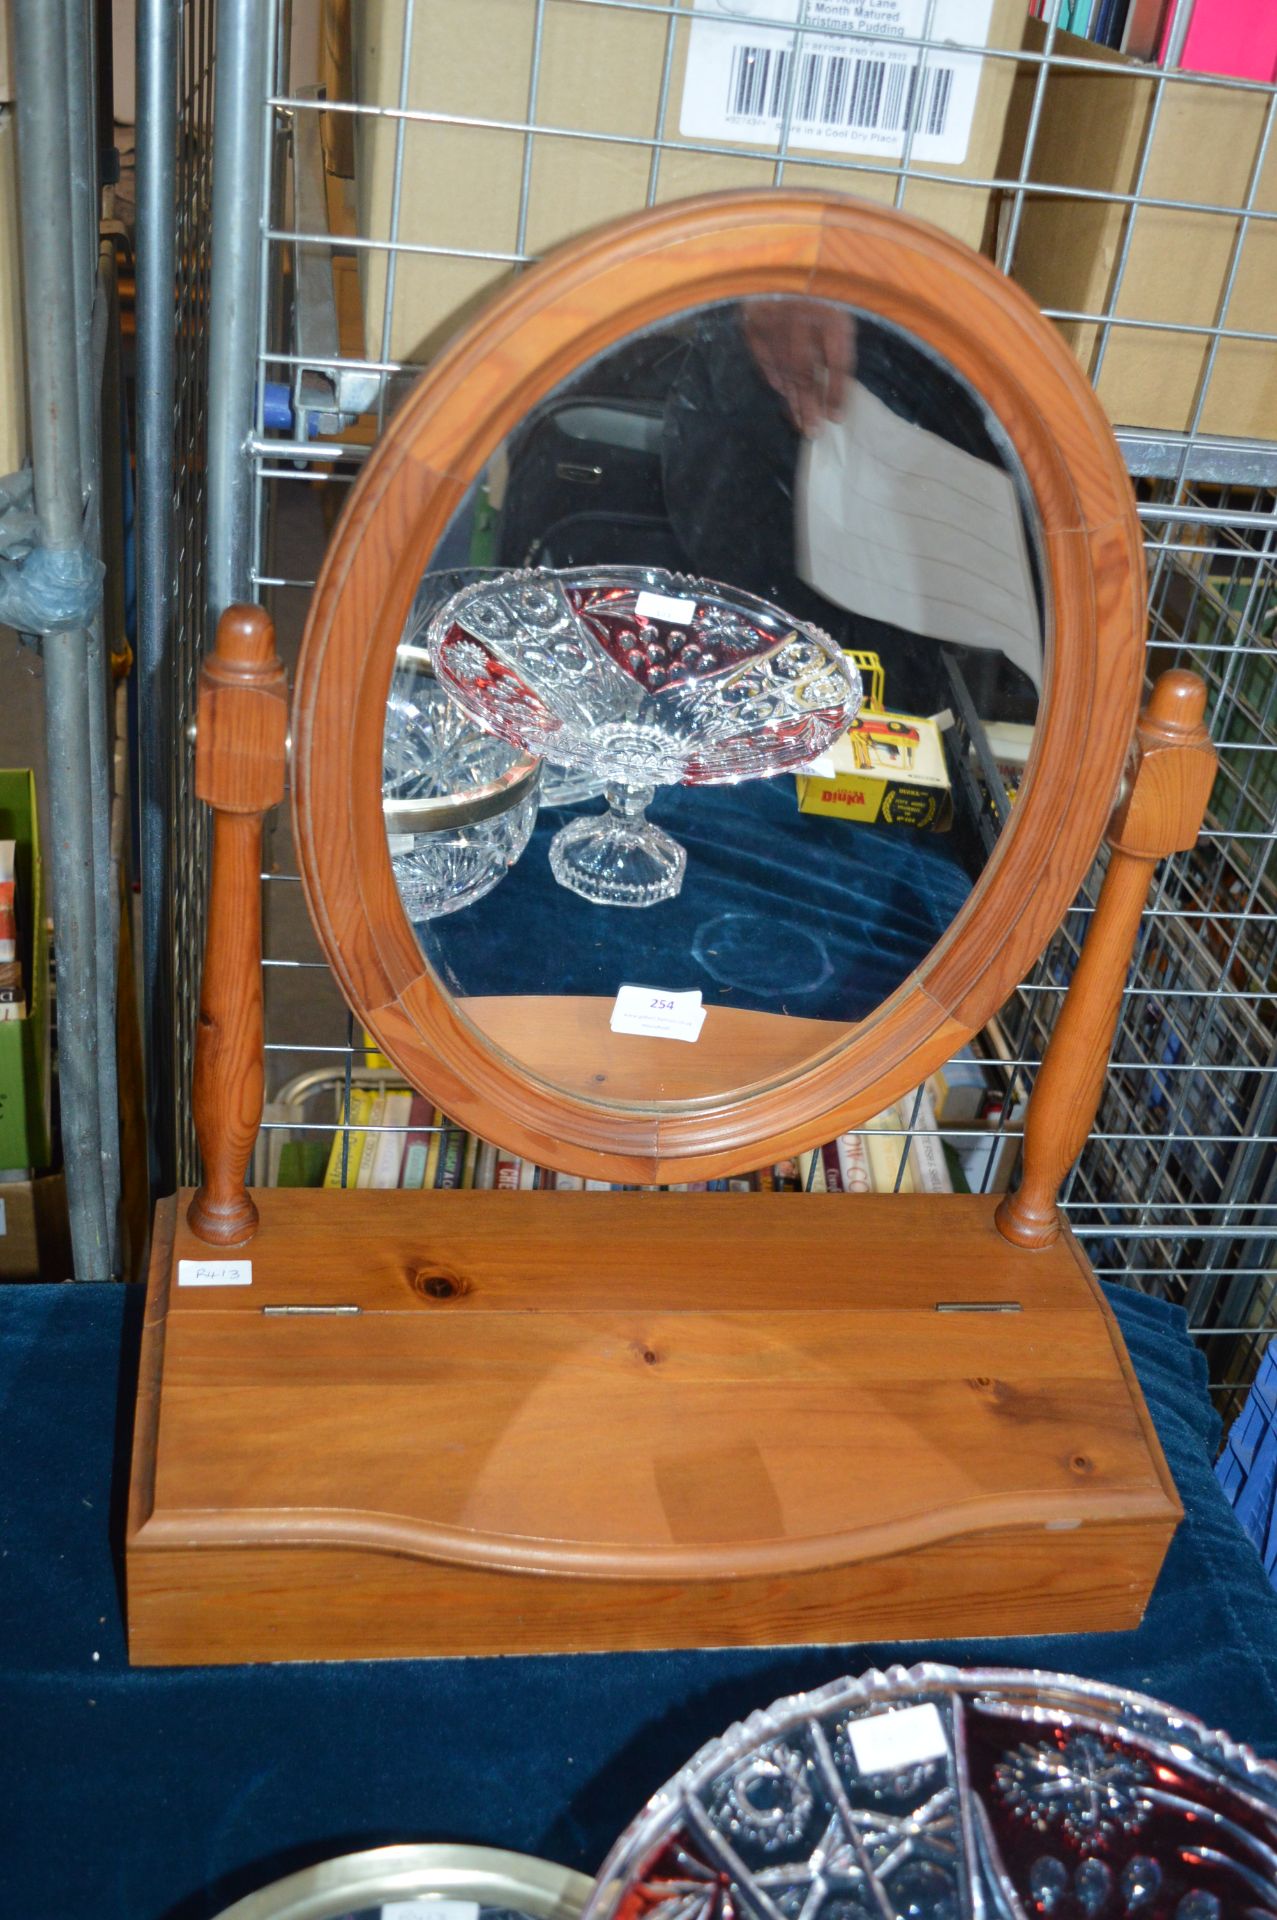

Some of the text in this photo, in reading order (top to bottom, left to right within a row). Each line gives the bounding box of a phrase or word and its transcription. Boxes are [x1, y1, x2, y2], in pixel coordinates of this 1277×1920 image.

[815, 2, 850, 16] Month
[854, 7, 900, 21] Matured
[858, 20, 905, 38] Pudding
[825, 128, 849, 139] Cool
[850, 129, 868, 142] Dry
[870, 132, 897, 144] Place
[649, 998, 675, 1010] 254
